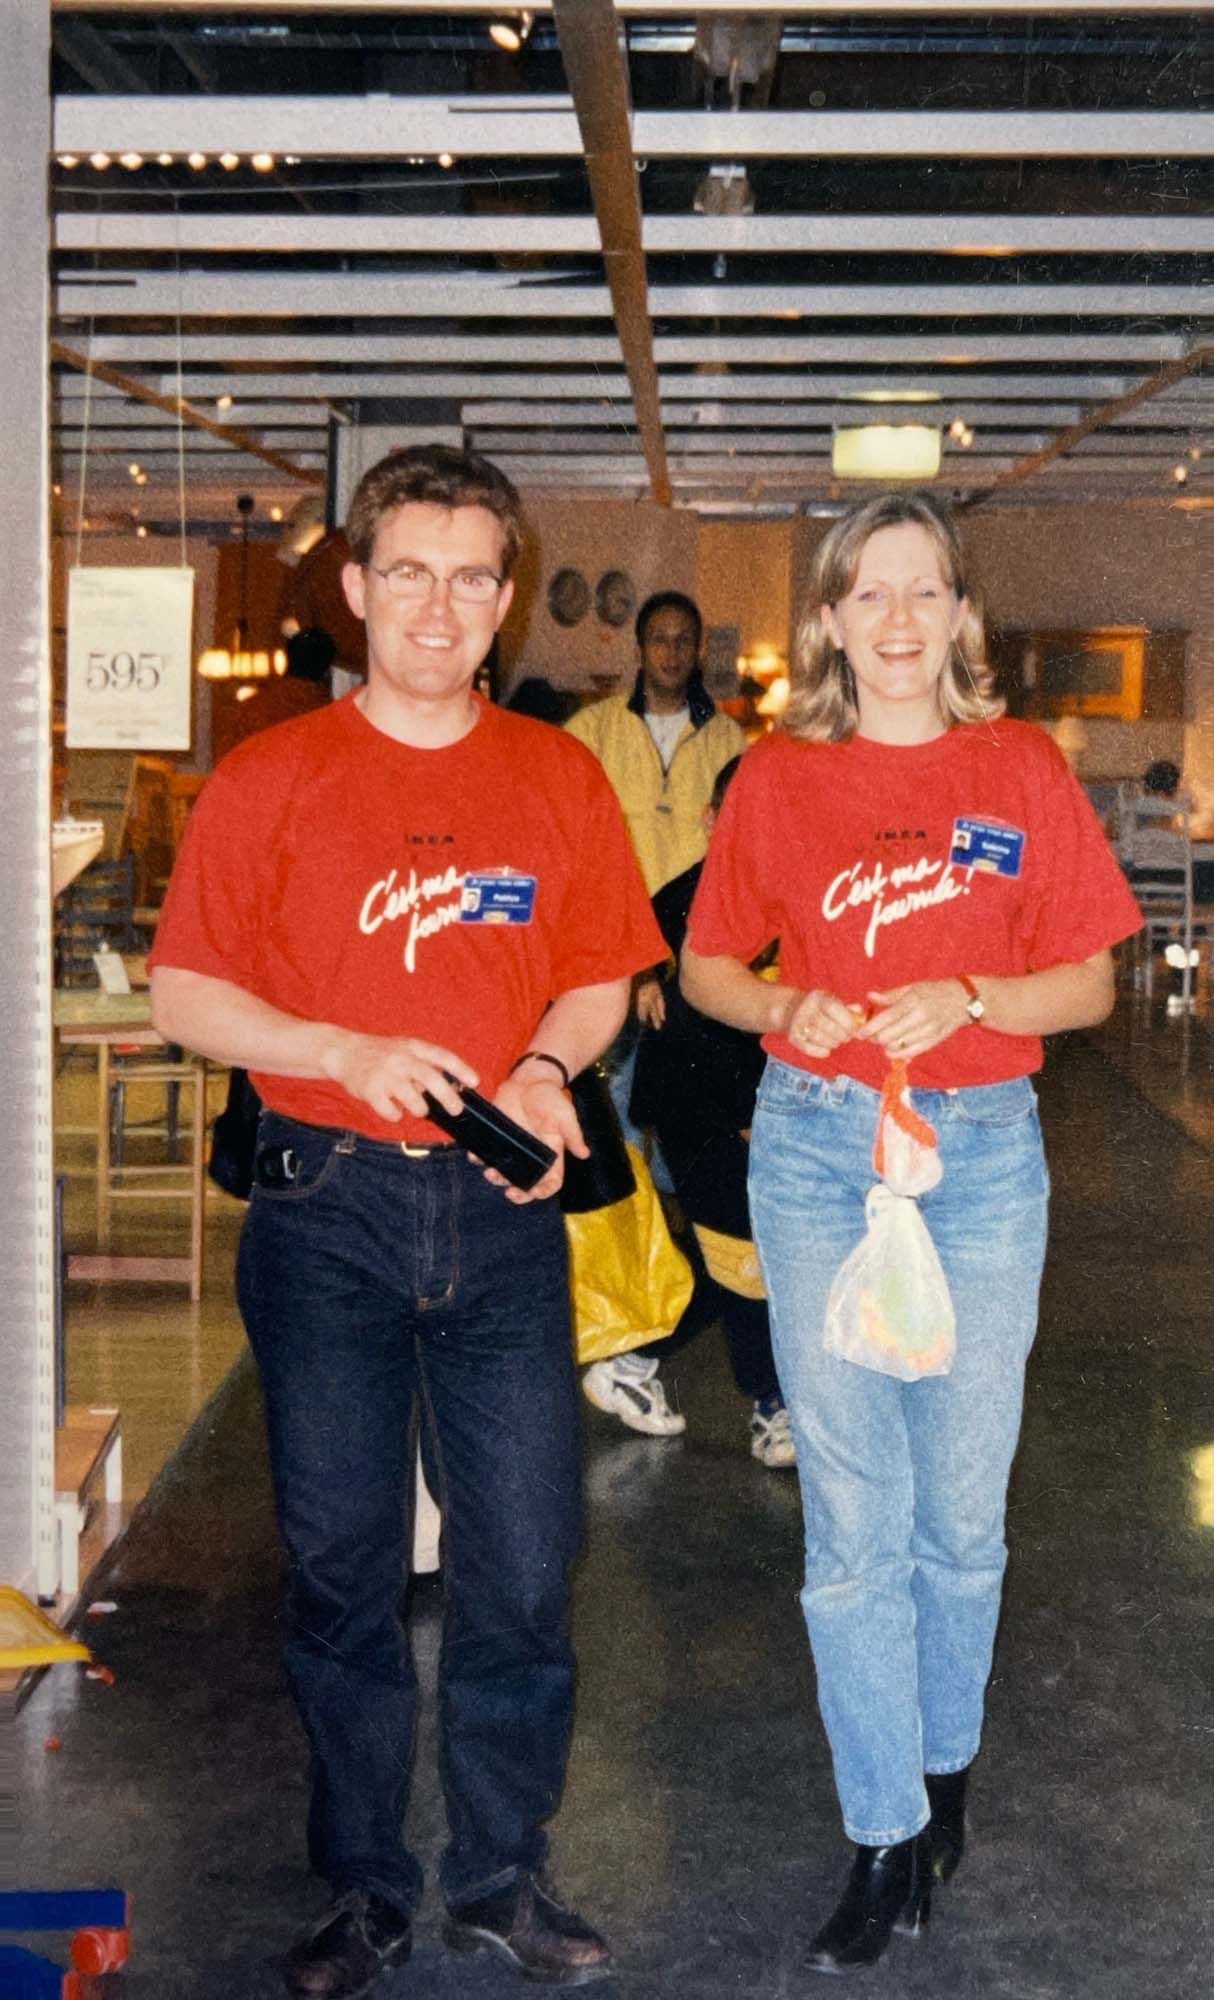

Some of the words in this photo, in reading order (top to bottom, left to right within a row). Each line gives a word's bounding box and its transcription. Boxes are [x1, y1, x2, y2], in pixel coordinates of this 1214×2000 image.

[358, 868, 421, 935] C'est
[822, 861, 888, 921] C'est
[890, 857, 943, 889] ma
